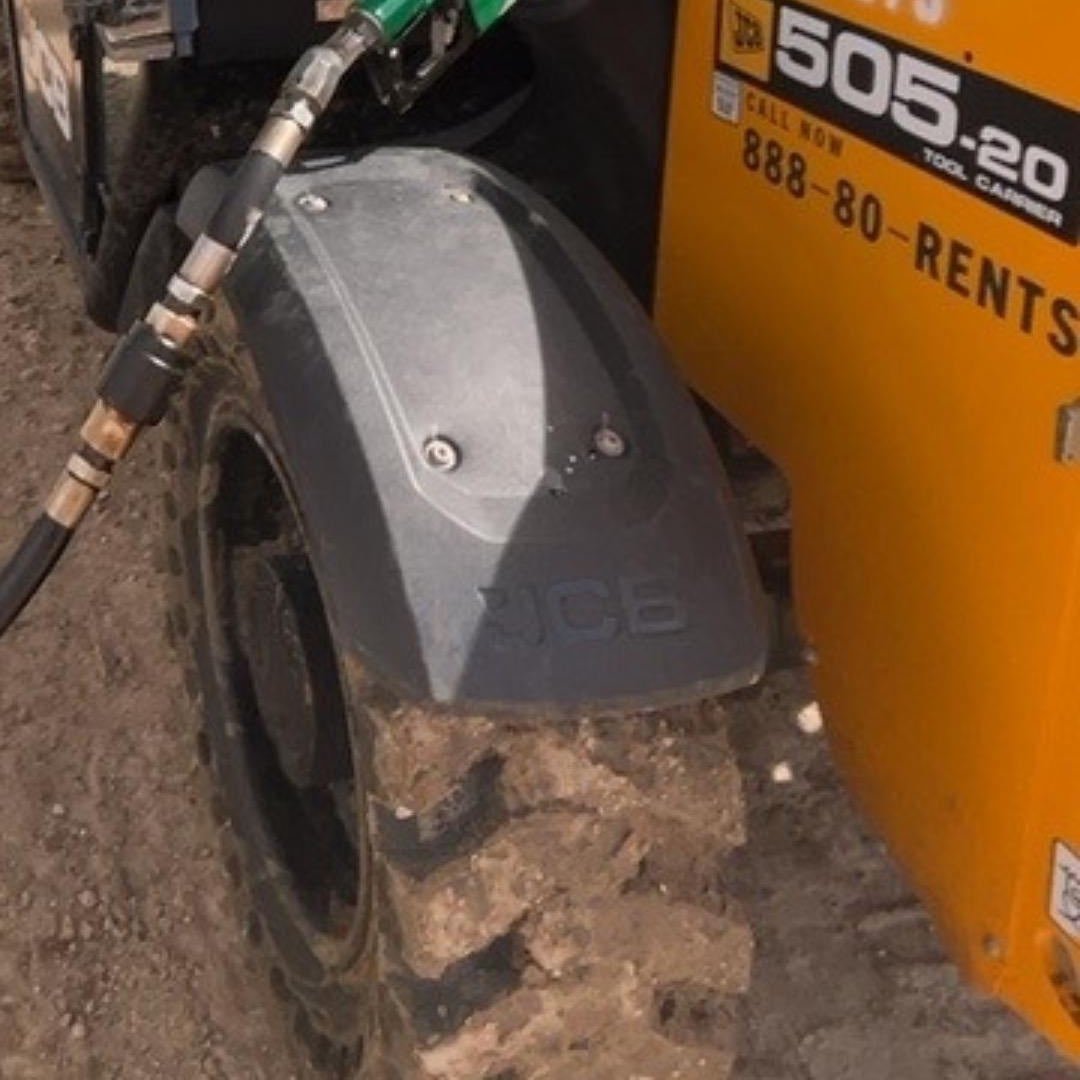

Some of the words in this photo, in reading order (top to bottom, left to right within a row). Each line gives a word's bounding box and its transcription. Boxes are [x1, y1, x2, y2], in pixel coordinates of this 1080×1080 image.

[746, 89, 791, 131] CALL
[799, 120, 845, 158] NOW
[923, 145, 969, 182] TOOL
[974, 172, 1064, 229] CARRIER
[742, 127, 1080, 357] 888-80-RENTS
